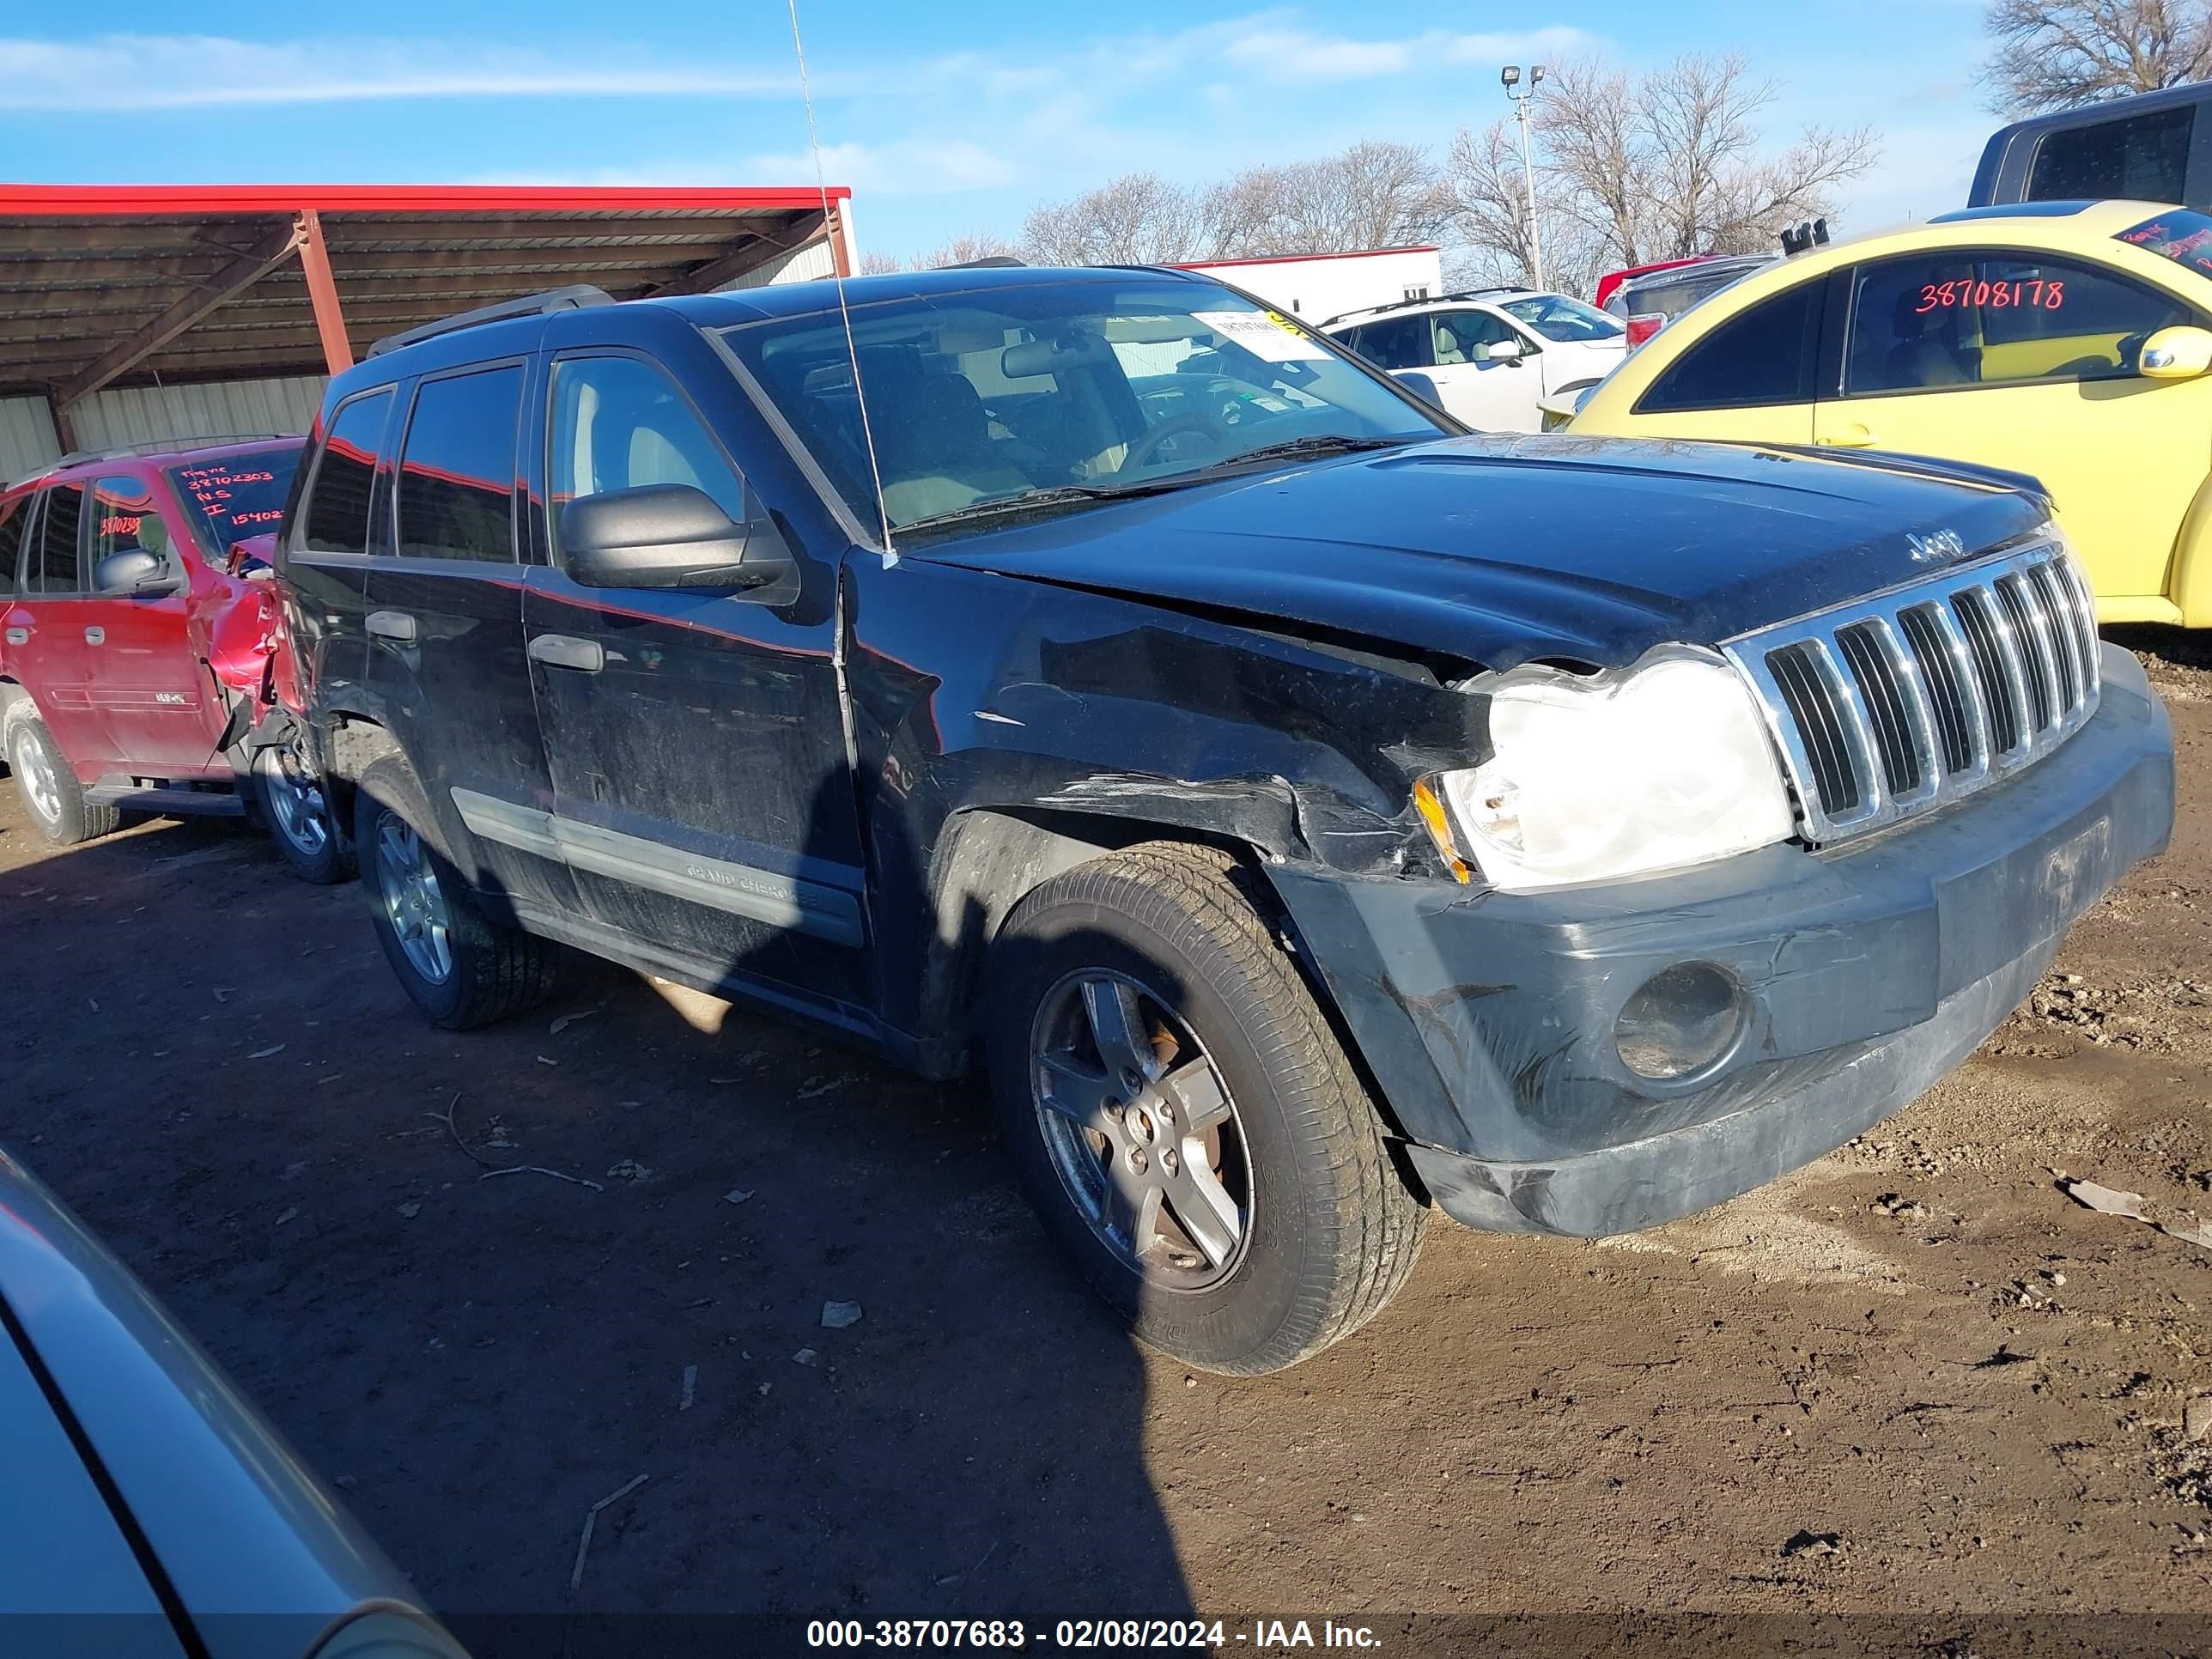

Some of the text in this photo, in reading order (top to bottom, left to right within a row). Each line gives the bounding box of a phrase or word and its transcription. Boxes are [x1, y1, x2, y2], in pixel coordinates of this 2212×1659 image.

[1915, 279, 2065, 313] 38708178
[188, 471, 274, 490] 38702303
[231, 510, 285, 526] 15402
[1905, 528, 1965, 563] Jeep
[687, 865, 735, 886] GRAND
